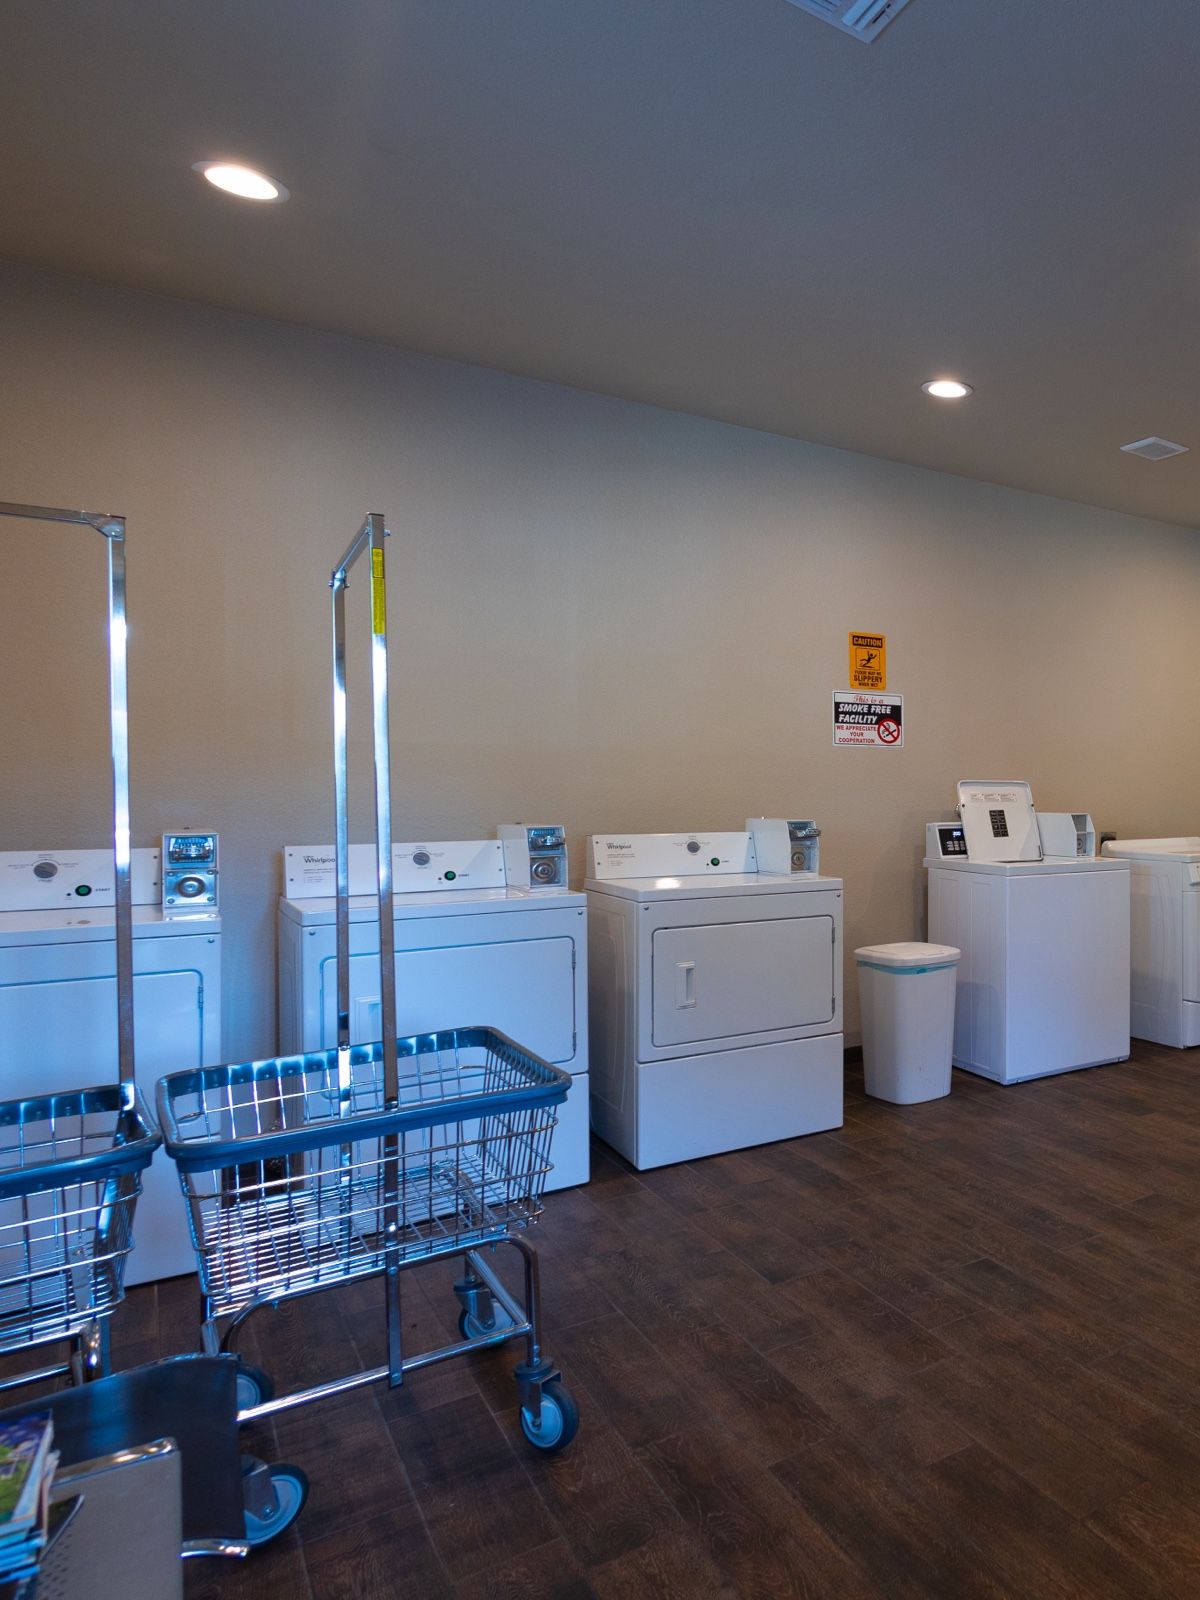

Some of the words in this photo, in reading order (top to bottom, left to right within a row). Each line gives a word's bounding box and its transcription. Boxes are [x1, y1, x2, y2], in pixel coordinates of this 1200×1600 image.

[853, 636, 882, 647] CAUTION
[853, 675, 882, 683] SLIPPERY
[853, 695, 869, 703] This
[838, 703, 869, 713] SMOKE
[870, 705, 892, 714] FREE
[838, 714, 878, 724] FACILITY
